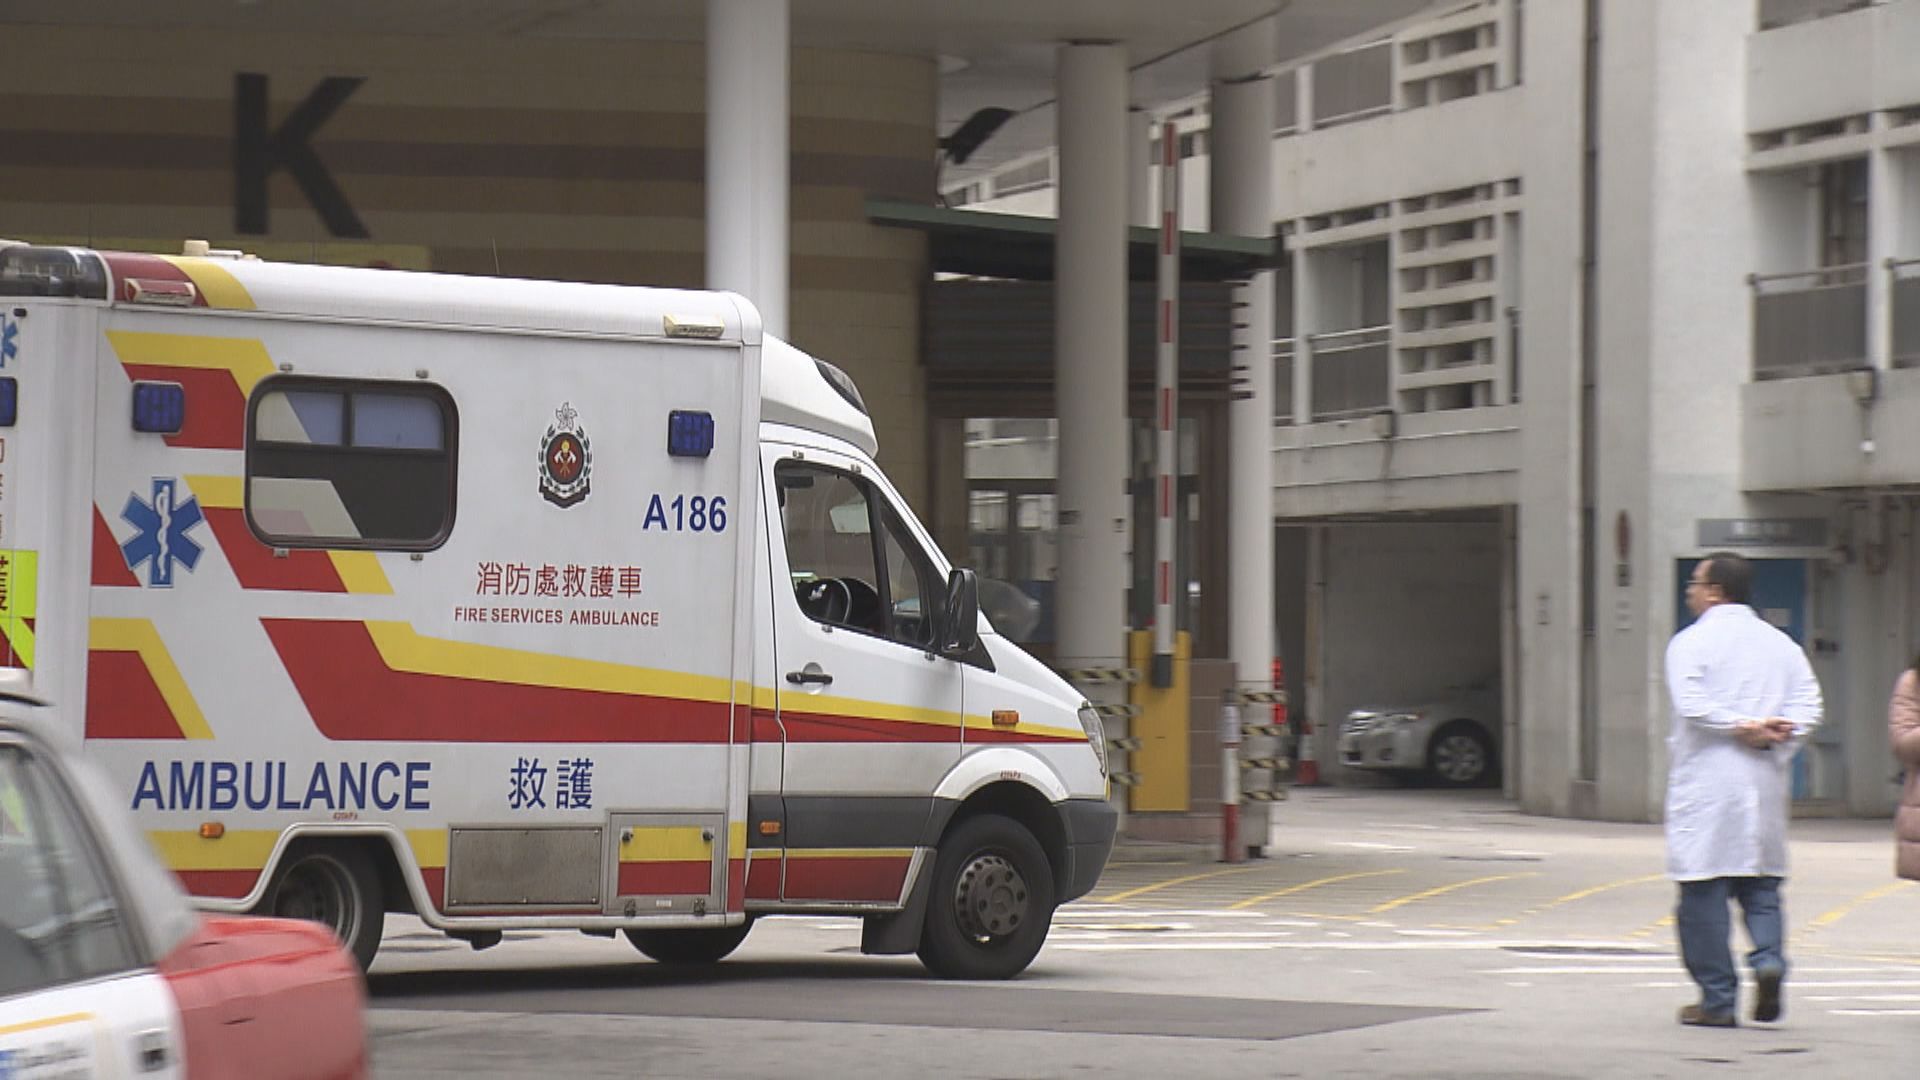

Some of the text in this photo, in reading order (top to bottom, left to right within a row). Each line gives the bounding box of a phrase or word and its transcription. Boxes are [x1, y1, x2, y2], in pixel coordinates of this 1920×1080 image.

[233, 72, 370, 239] K
[643, 494, 727, 533] A186
[476, 561, 643, 599] 消防處救護車
[454, 606, 660, 627] FIRE SERVICES AMBULANCE
[131, 761, 432, 811] AMBULANCE
[508, 757, 594, 811] 救護
